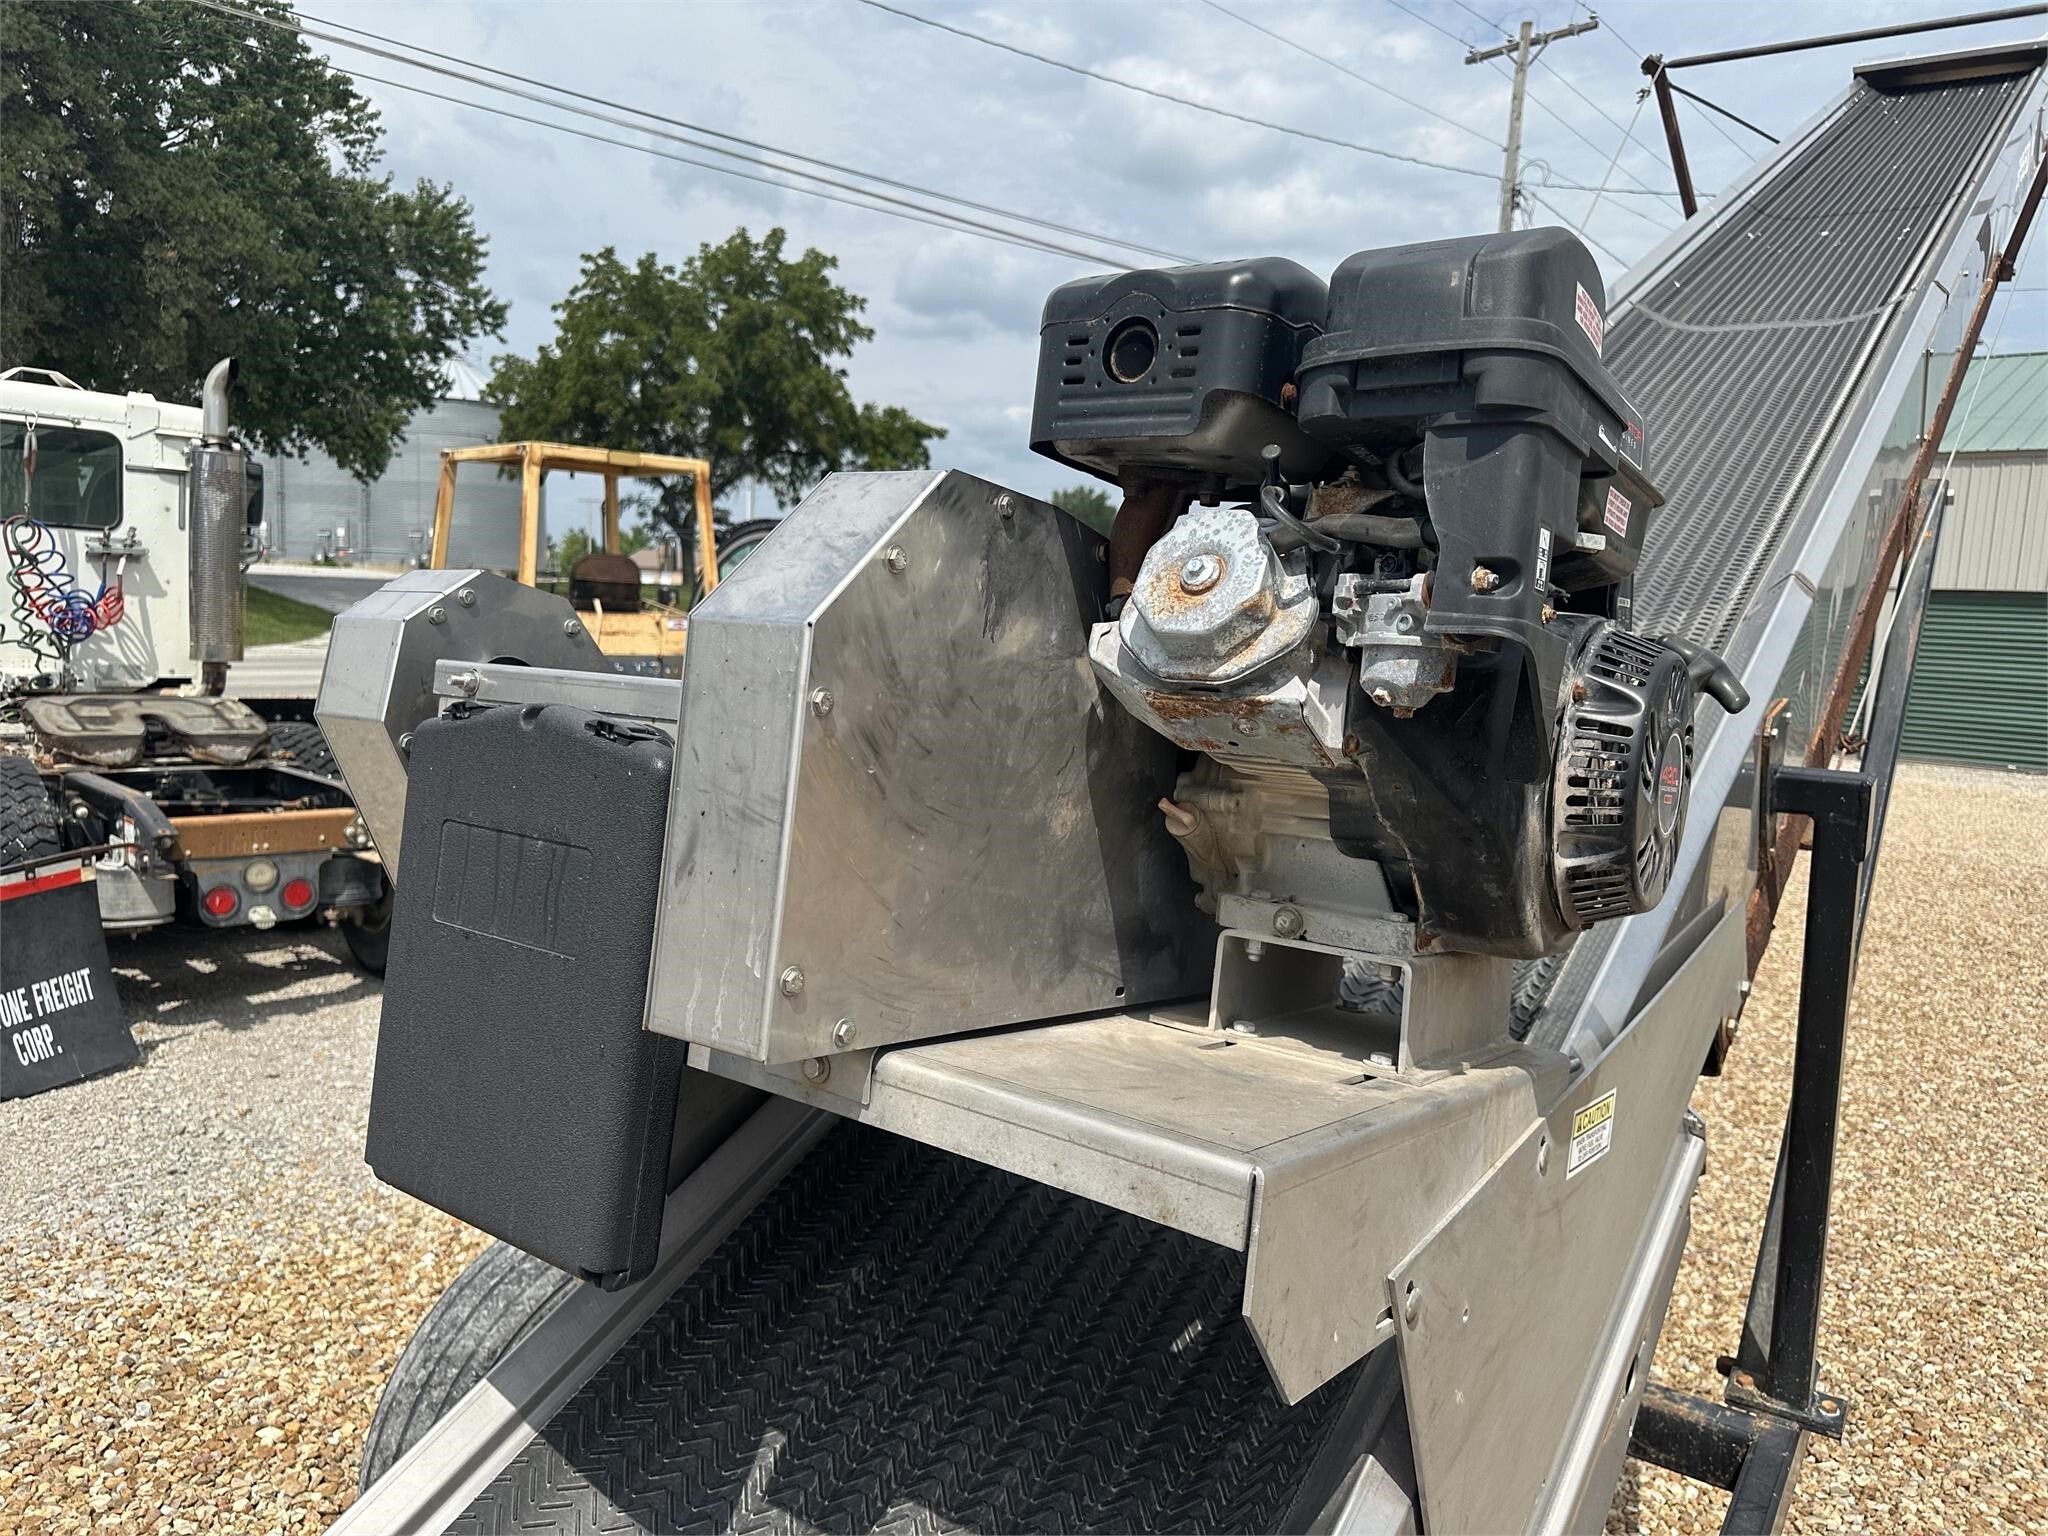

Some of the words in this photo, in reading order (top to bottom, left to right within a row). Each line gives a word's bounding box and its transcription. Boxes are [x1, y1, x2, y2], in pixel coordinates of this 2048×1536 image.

[0, 987, 33, 1029] ONE
[31, 967, 94, 1017] FREIGHT
[12, 1023, 63, 1066] CORP.
[1582, 1100, 1611, 1130] CAUTION
